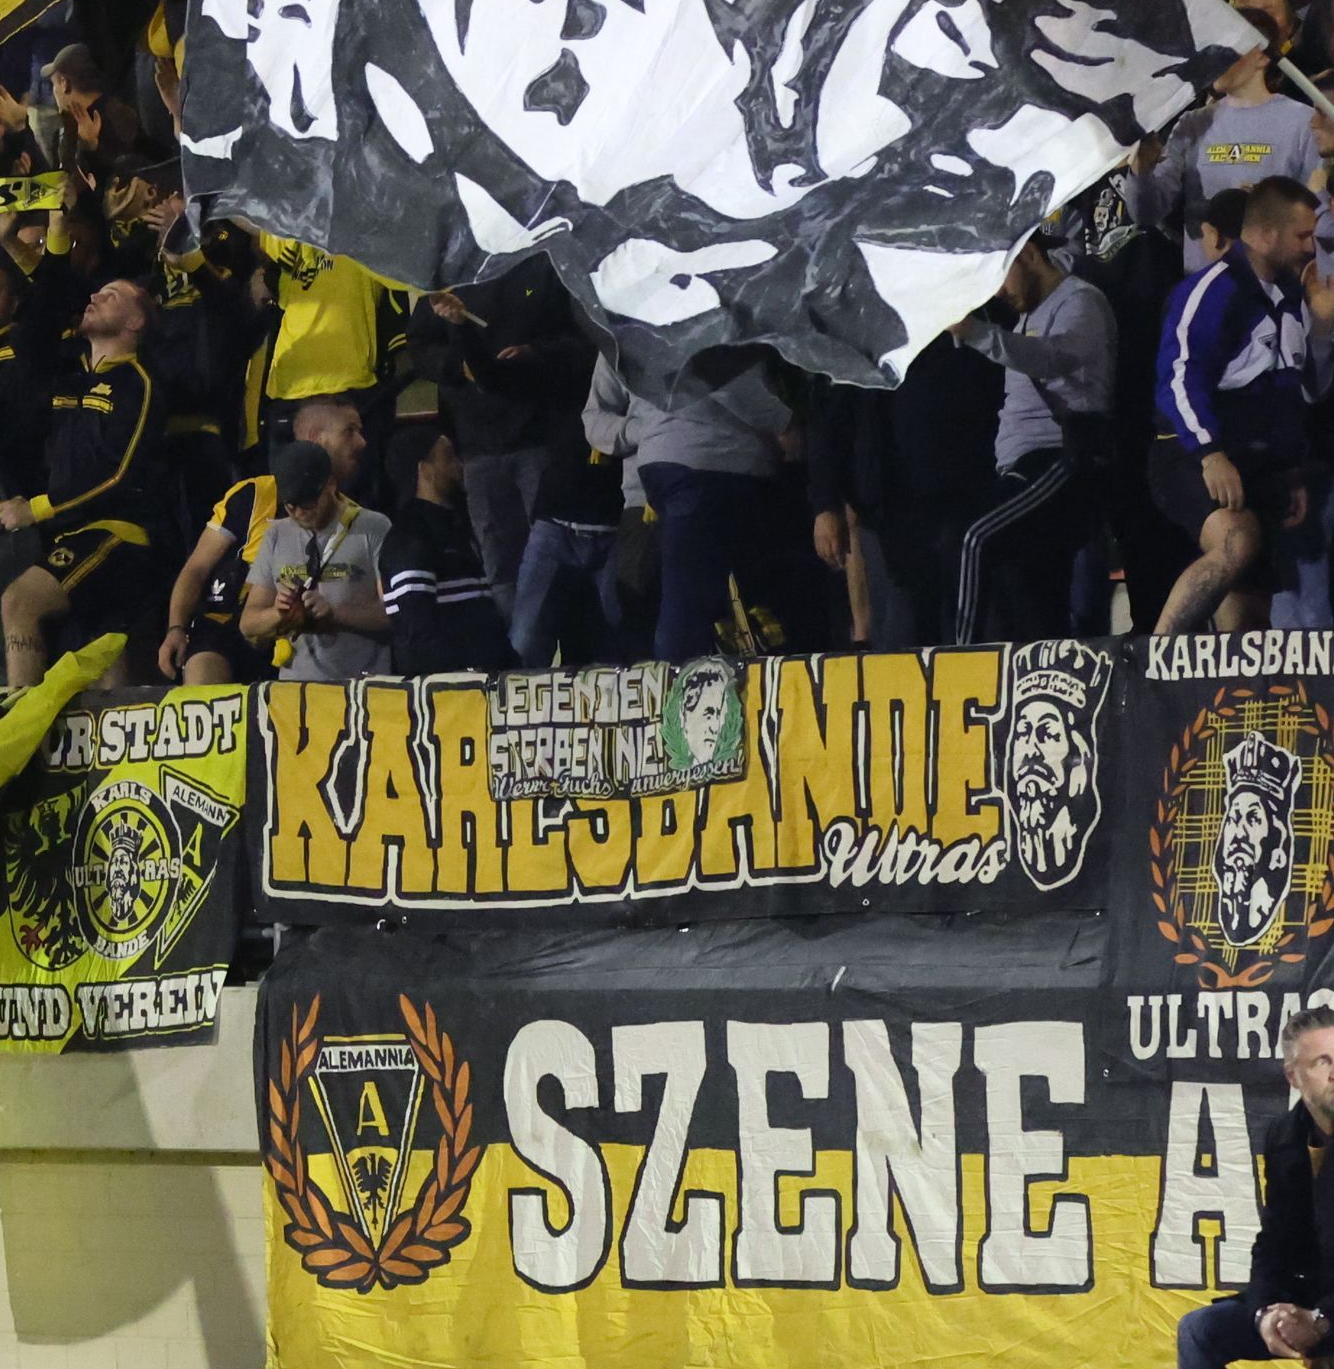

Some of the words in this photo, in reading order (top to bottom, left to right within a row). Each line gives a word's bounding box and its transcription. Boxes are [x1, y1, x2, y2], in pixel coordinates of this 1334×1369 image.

[489, 661, 667, 727] LEGENDEN
[99, 694, 244, 768] STADT
[489, 726, 605, 781] STERBEN
[91, 779, 153, 813] KARLS
[556, 770, 615, 800] Fuchs
[822, 820, 1009, 889] Ultras
[76, 970, 229, 1037] VEREIN
[317, 1047, 415, 1070] ALEMANNIA
[356, 1080, 390, 1137] A
[503, 1018, 1094, 1293] SZENE
